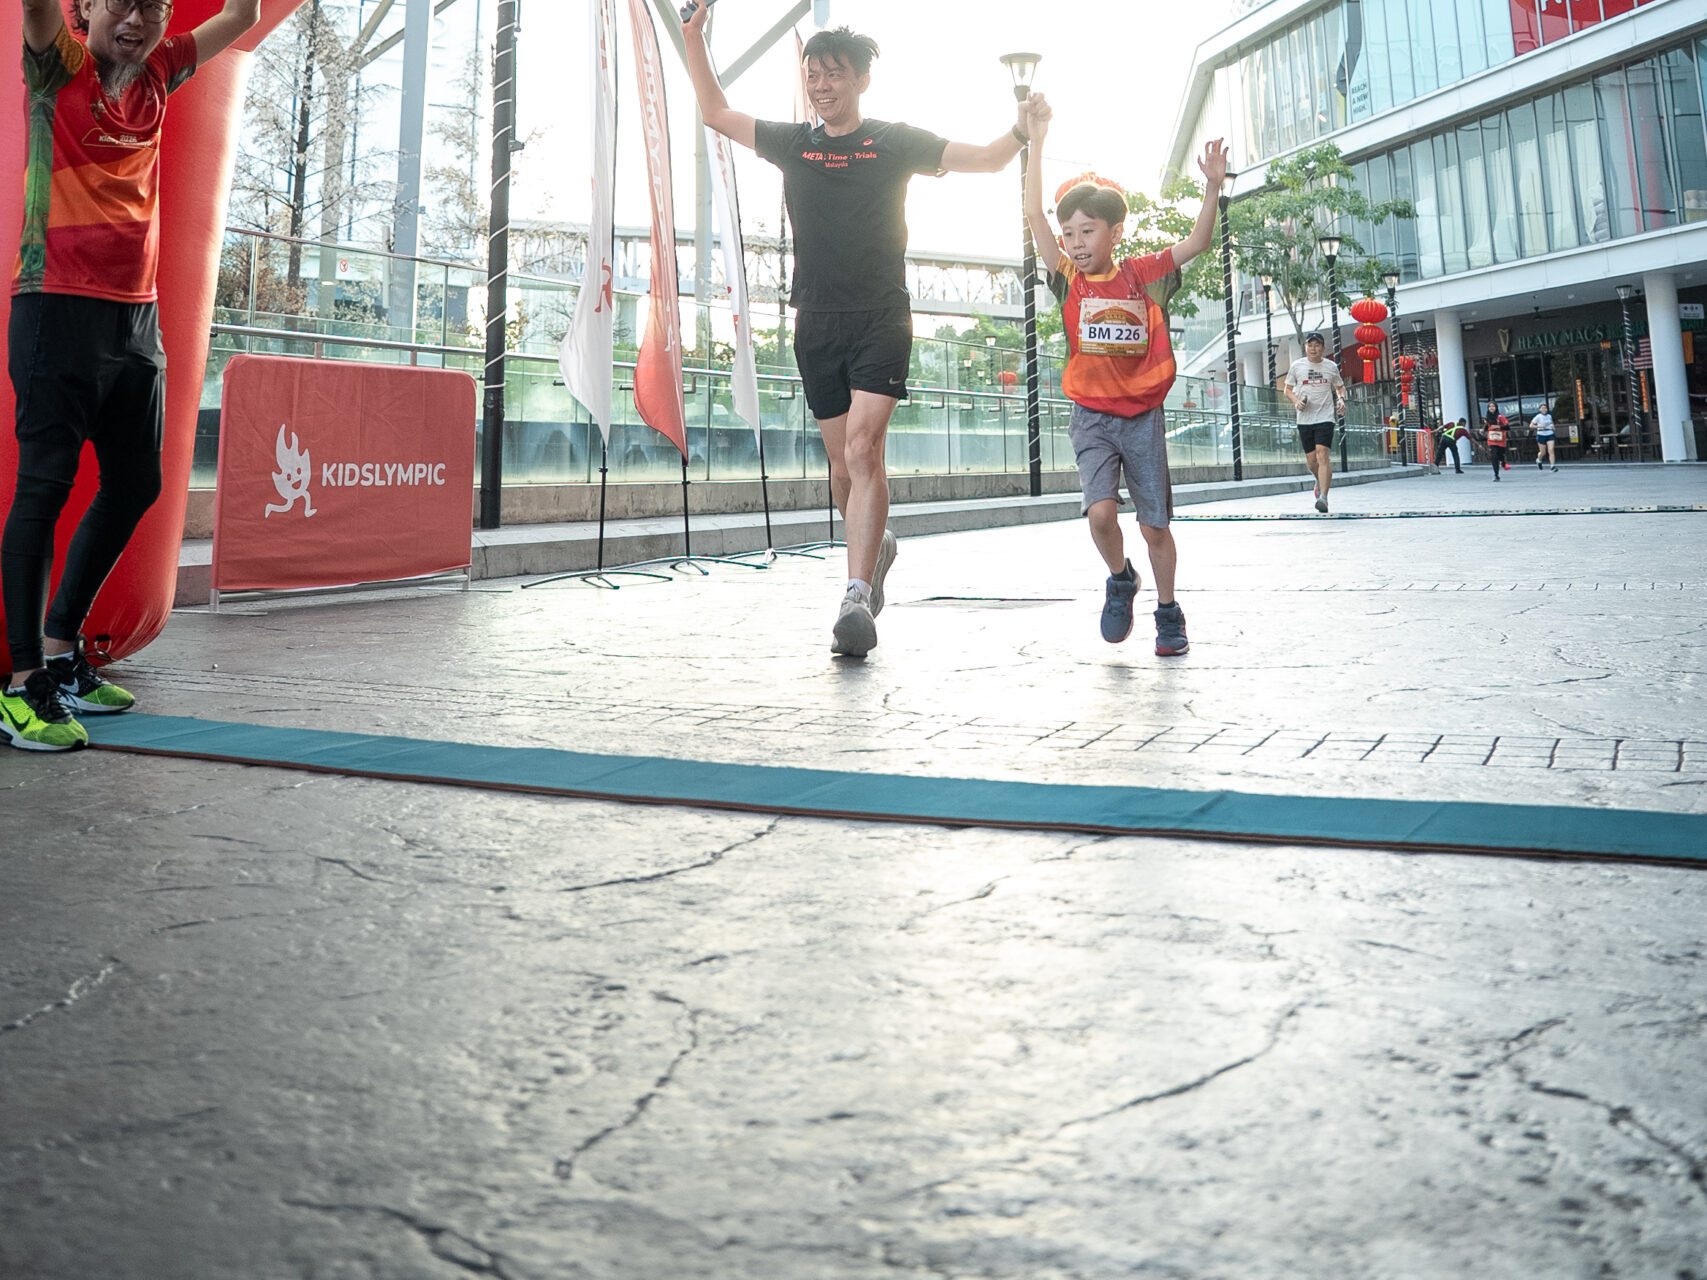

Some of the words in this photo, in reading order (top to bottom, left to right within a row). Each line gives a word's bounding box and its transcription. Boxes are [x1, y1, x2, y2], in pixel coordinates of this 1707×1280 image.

[1088, 326, 1111, 340] BM
[1115, 328, 1140, 341] 226
[1517, 330, 1558, 350] HEALY
[1561, 324, 1604, 344] MAC'S
[321, 463, 446, 487] KIDSLYMPIC
